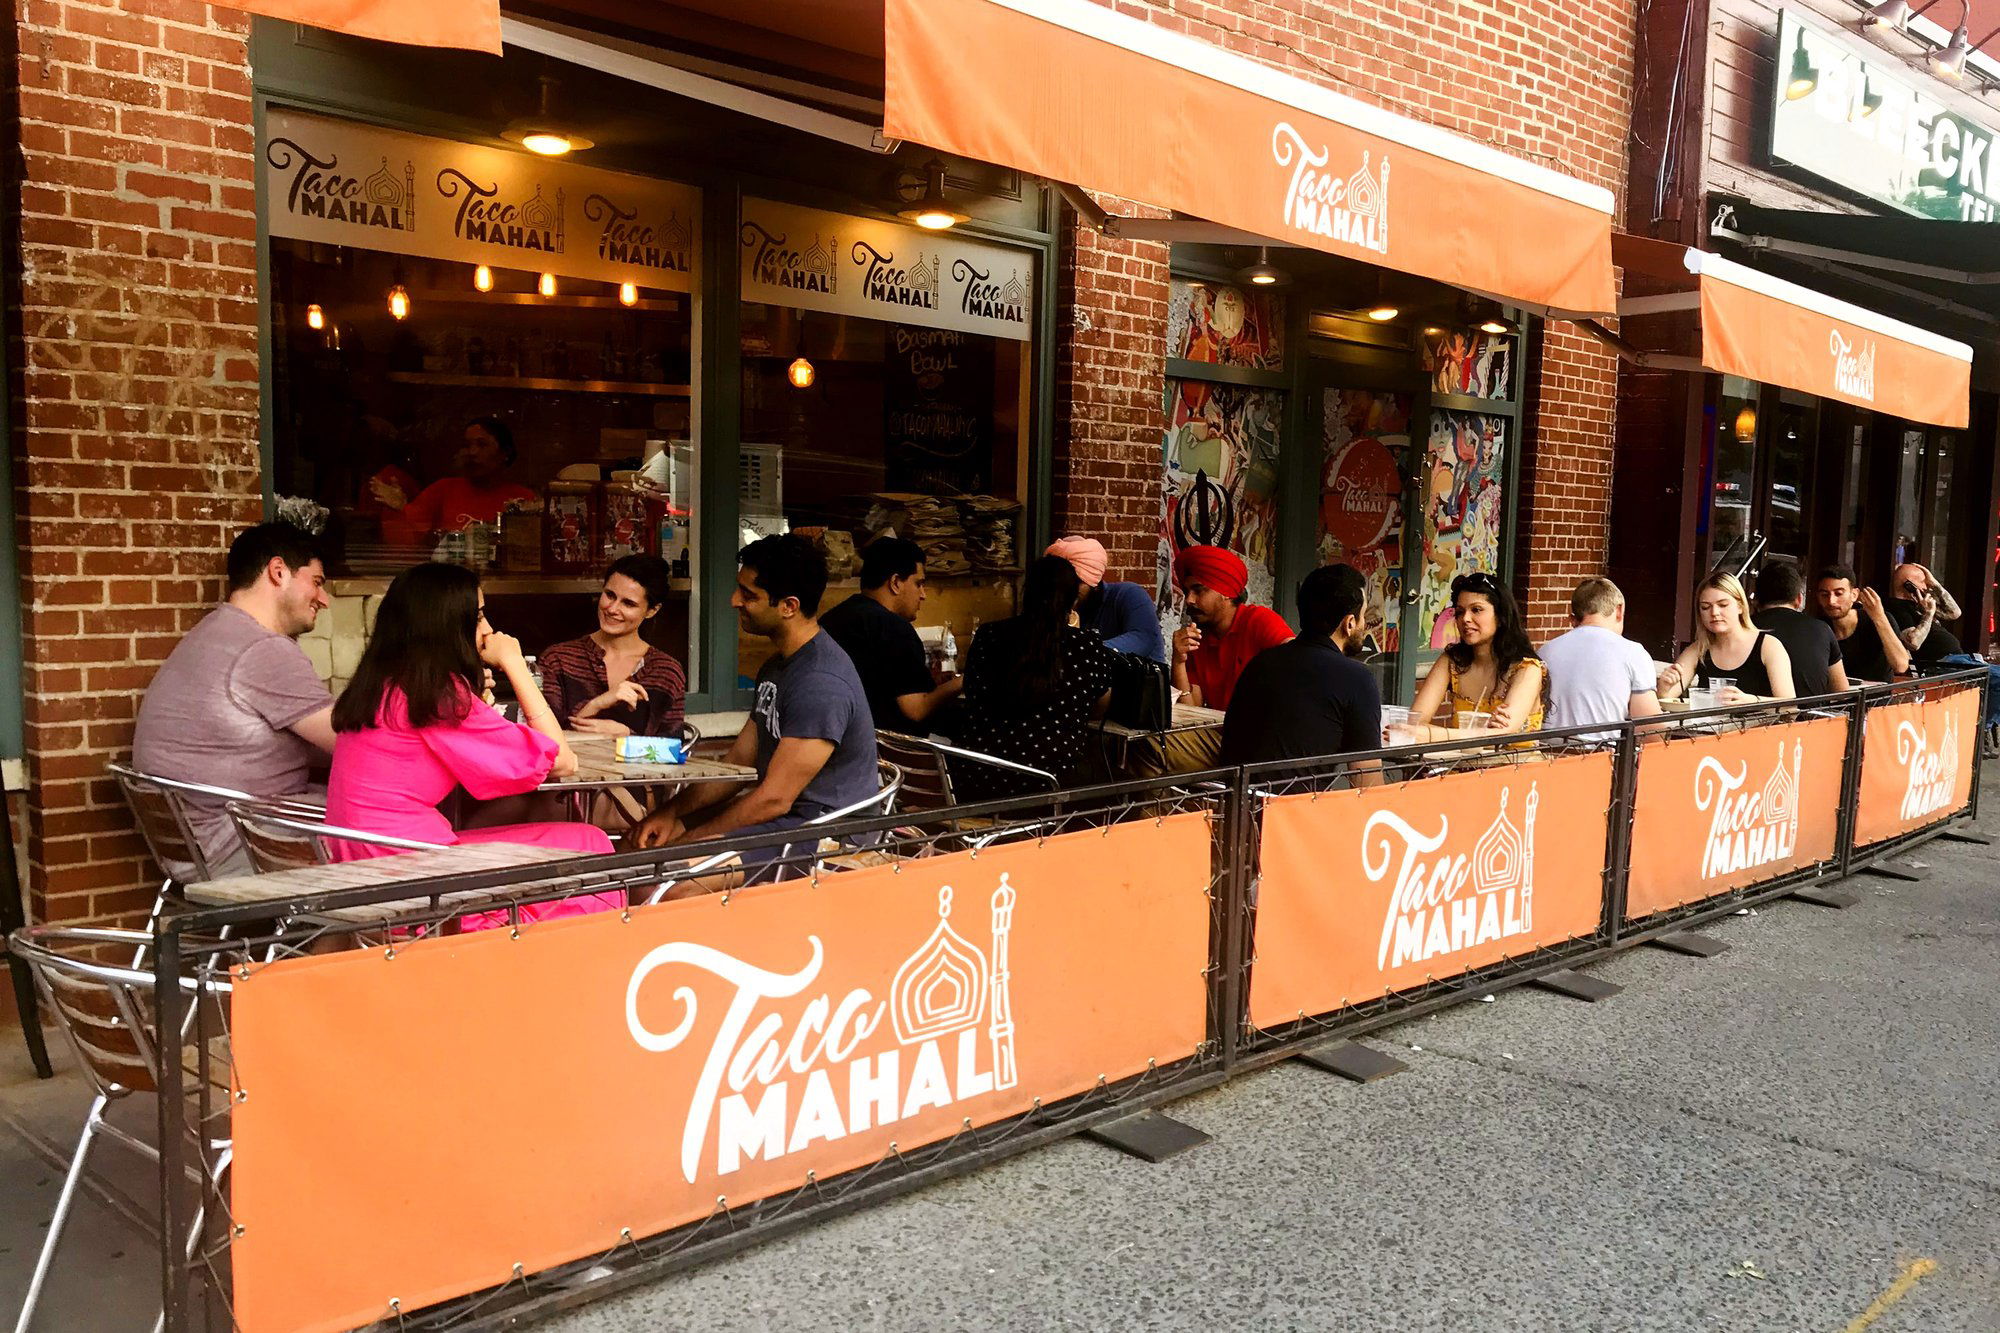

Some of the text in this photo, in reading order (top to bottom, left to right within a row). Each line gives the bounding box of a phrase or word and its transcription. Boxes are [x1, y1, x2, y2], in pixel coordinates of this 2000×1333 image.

[267, 137, 363, 214] Taco
[1272, 122, 1347, 226] Taco
[301, 192, 404, 231] MAHAL
[436, 168, 520, 238] Taco
[584, 193, 657, 260] Taco
[1295, 196, 1381, 251] MAHAL
[466, 218, 555, 253] MAHAL
[609, 240, 689, 272] MAHAL
[741, 221, 802, 282] Taco
[761, 265, 829, 293] MAHAL
[852, 241, 908, 299] Taco
[870, 282, 932, 309] MAHAL
[952, 259, 1003, 313] Taco
[969, 298, 1024, 323] MAHAL
[1829, 328, 1858, 392] Taco
[1839, 374, 1873, 401] MAHAL
[1336, 475, 1368, 511] Taco
[1346, 500, 1382, 513] MAHAL
[1898, 720, 1942, 820] Taco
[1695, 755, 1764, 880] Taco
[1905, 780, 1955, 820] MAHAL
[1709, 822, 1790, 879] MAHAL
[1361, 809, 1472, 972] Taco
[1391, 887, 1521, 968] MAHAL
[625, 935, 887, 1185] Taco
[717, 1027, 995, 1176] MAHAL
